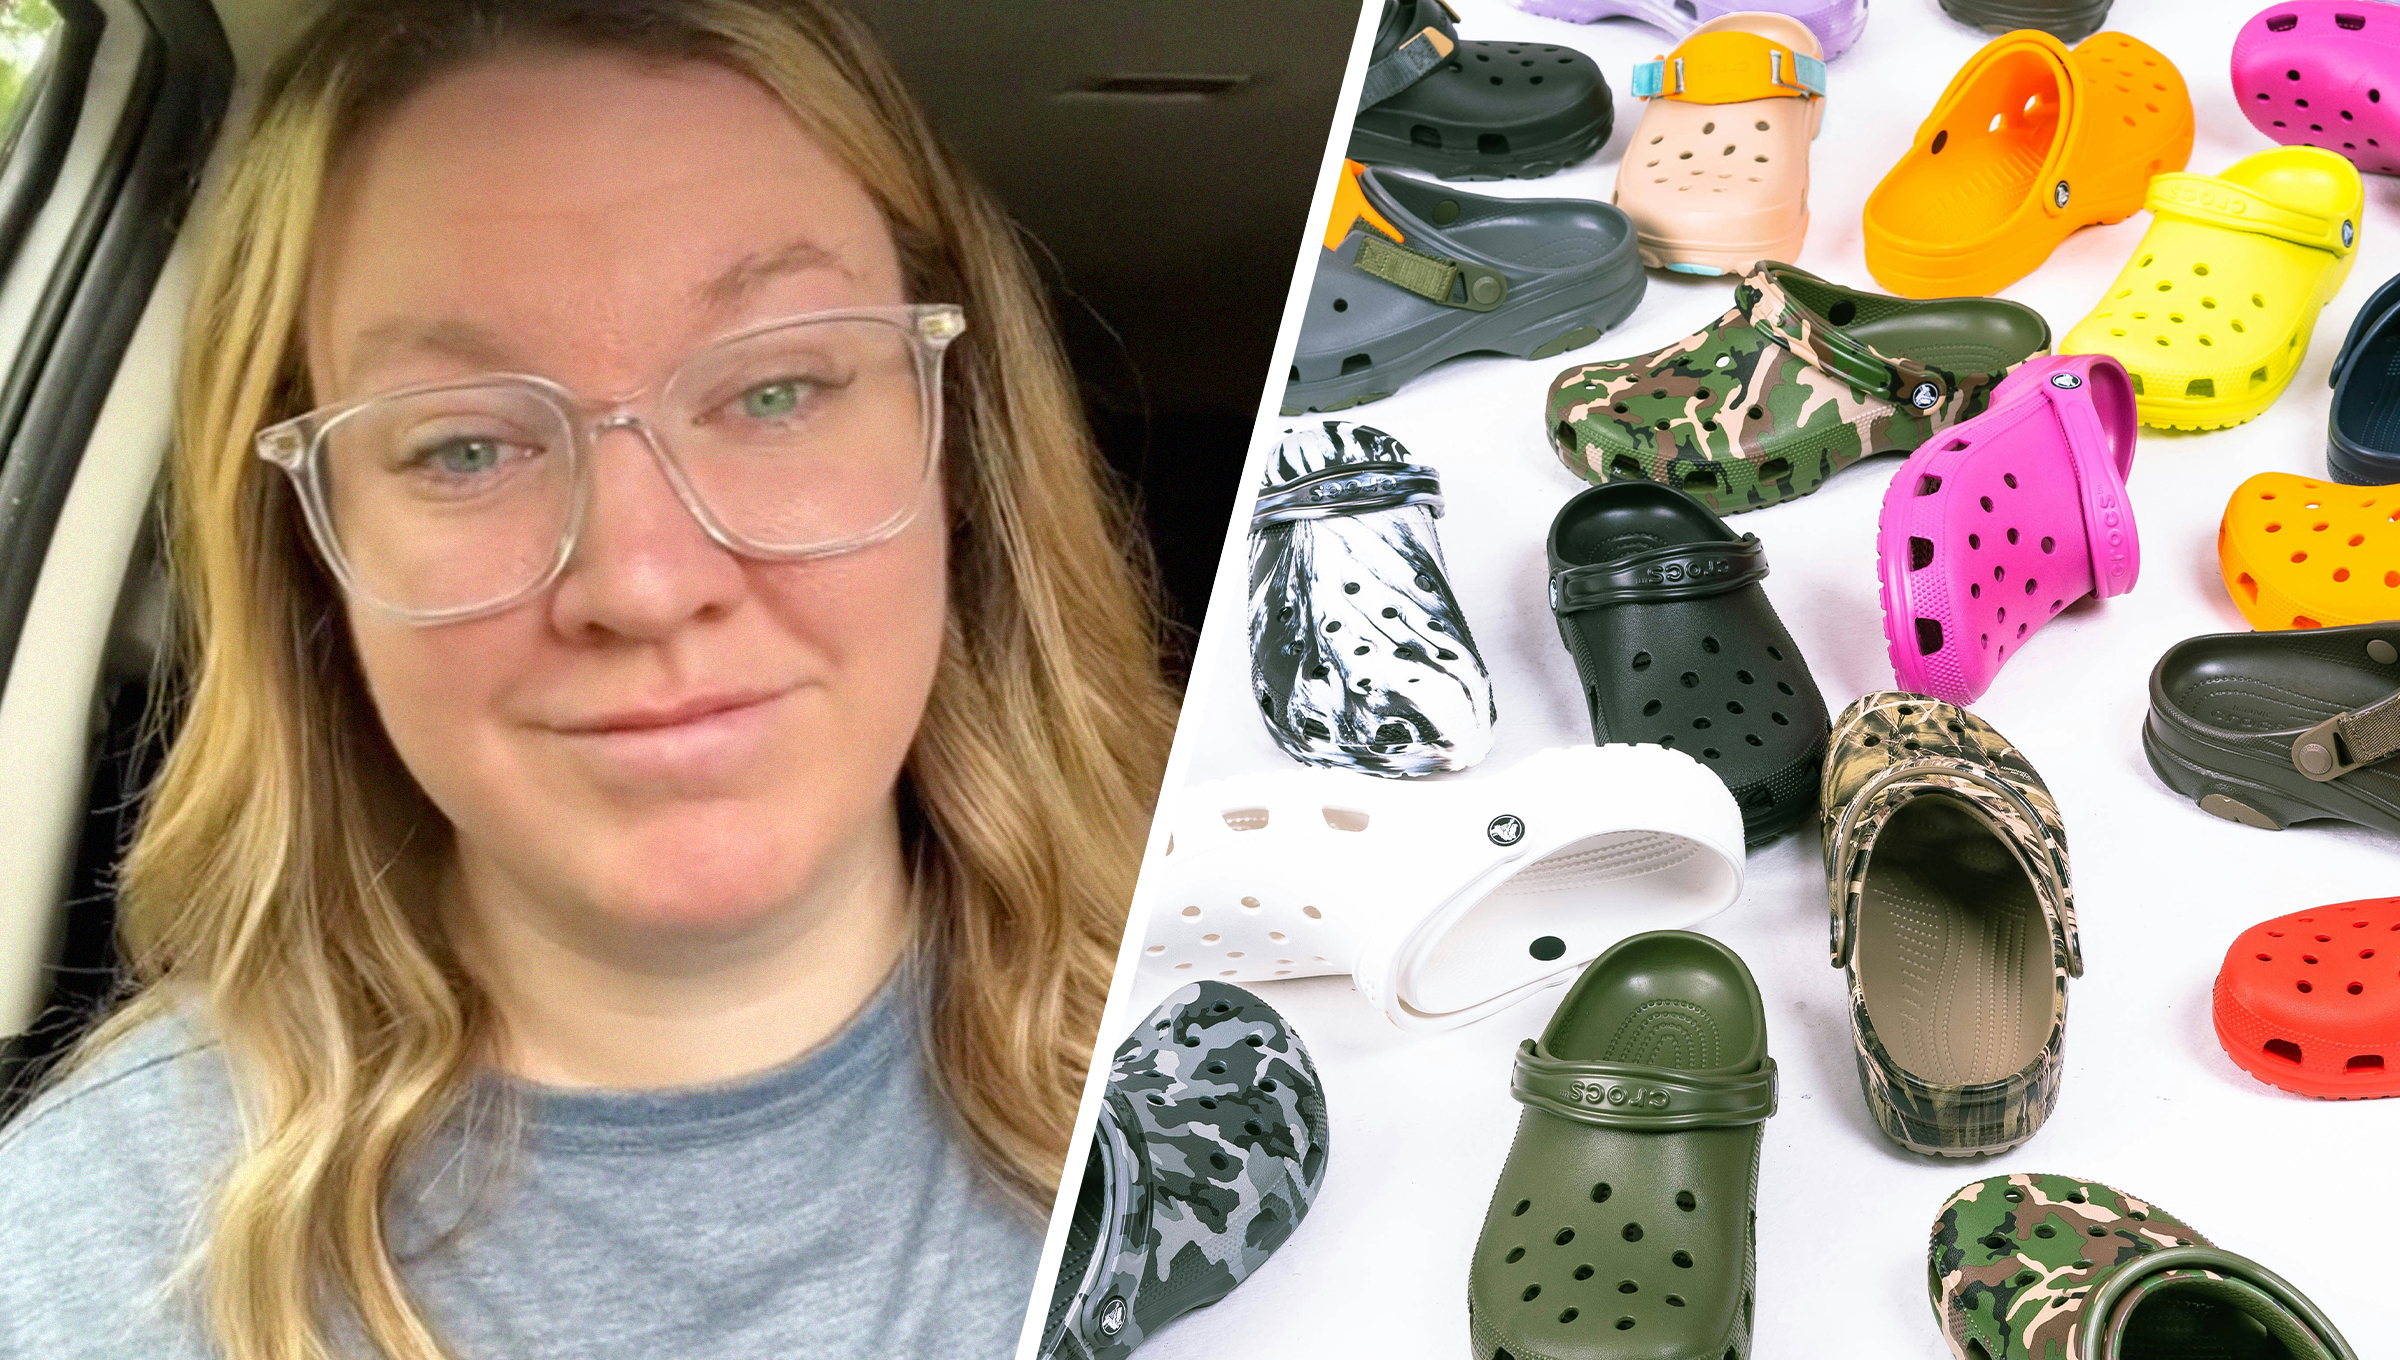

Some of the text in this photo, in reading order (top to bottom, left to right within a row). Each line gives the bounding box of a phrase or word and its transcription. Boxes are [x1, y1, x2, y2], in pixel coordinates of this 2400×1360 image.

[2169, 186, 2247, 215] crocs
[2100, 494, 2126, 577] crocs
[1647, 558, 1730, 585] crocs
[1570, 1081, 1671, 1110] crocs
